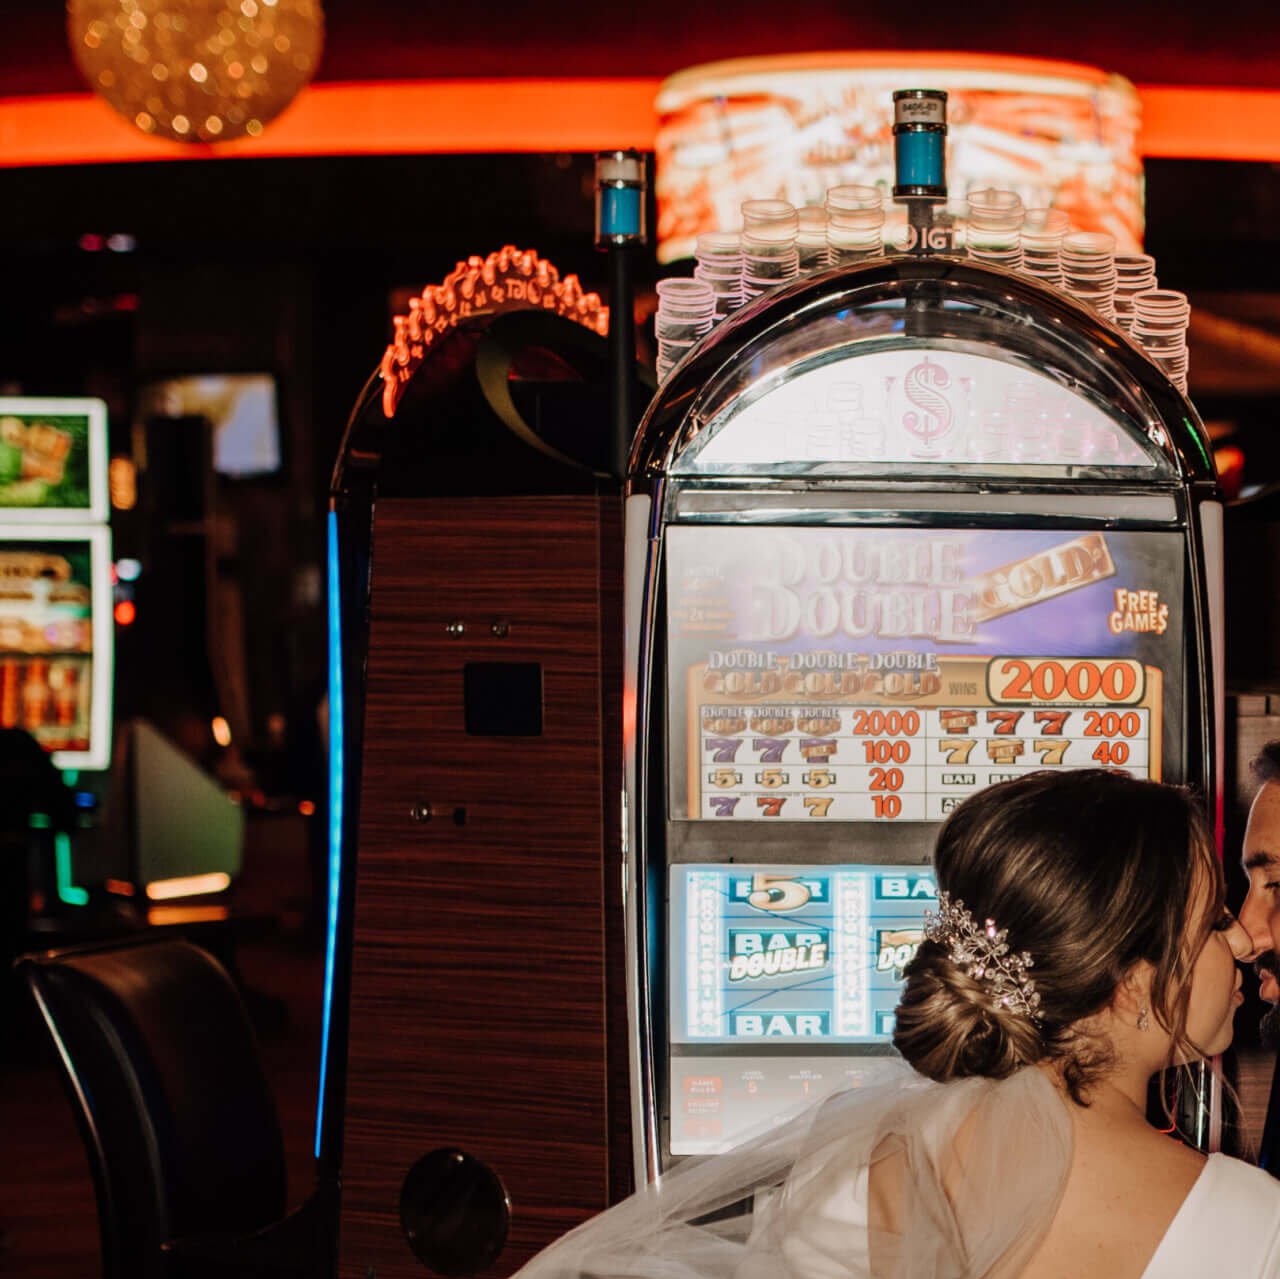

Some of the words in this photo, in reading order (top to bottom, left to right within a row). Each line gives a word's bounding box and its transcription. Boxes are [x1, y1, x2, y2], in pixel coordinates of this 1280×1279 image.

[921, 226, 957, 249] IGT
[775, 535, 963, 586] DOUBLE
[748, 583, 978, 643] DOUBLE
[1115, 589, 1158, 613] FREE
[709, 652, 778, 670] DOUBLE
[789, 652, 859, 670] DOUBLE
[867, 653, 936, 671] DOUBLE
[949, 682, 977, 696] WINS
[1001, 660, 1137, 701] 2000
[852, 710, 920, 736] 2000
[986, 710, 1024, 735] 7
[1033, 710, 1072, 735] 7
[1083, 711, 1140, 737] 200
[705, 739, 744, 763] 7
[752, 739, 791, 763] 7
[862, 740, 910, 764] 100
[939, 740, 978, 764] 7
[1033, 740, 1072, 764] 7
[1092, 741, 1129, 765] 40
[869, 768, 904, 792] 20
[943, 775, 975, 784] BAR
[710, 797, 741, 817] 7
[757, 797, 787, 817] 7
[804, 797, 834, 817] 7
[872, 795, 901, 818] 10
[882, 879, 937, 897] BA
[731, 944, 827, 981] DOUBLE
[736, 1015, 822, 1035] BAR
